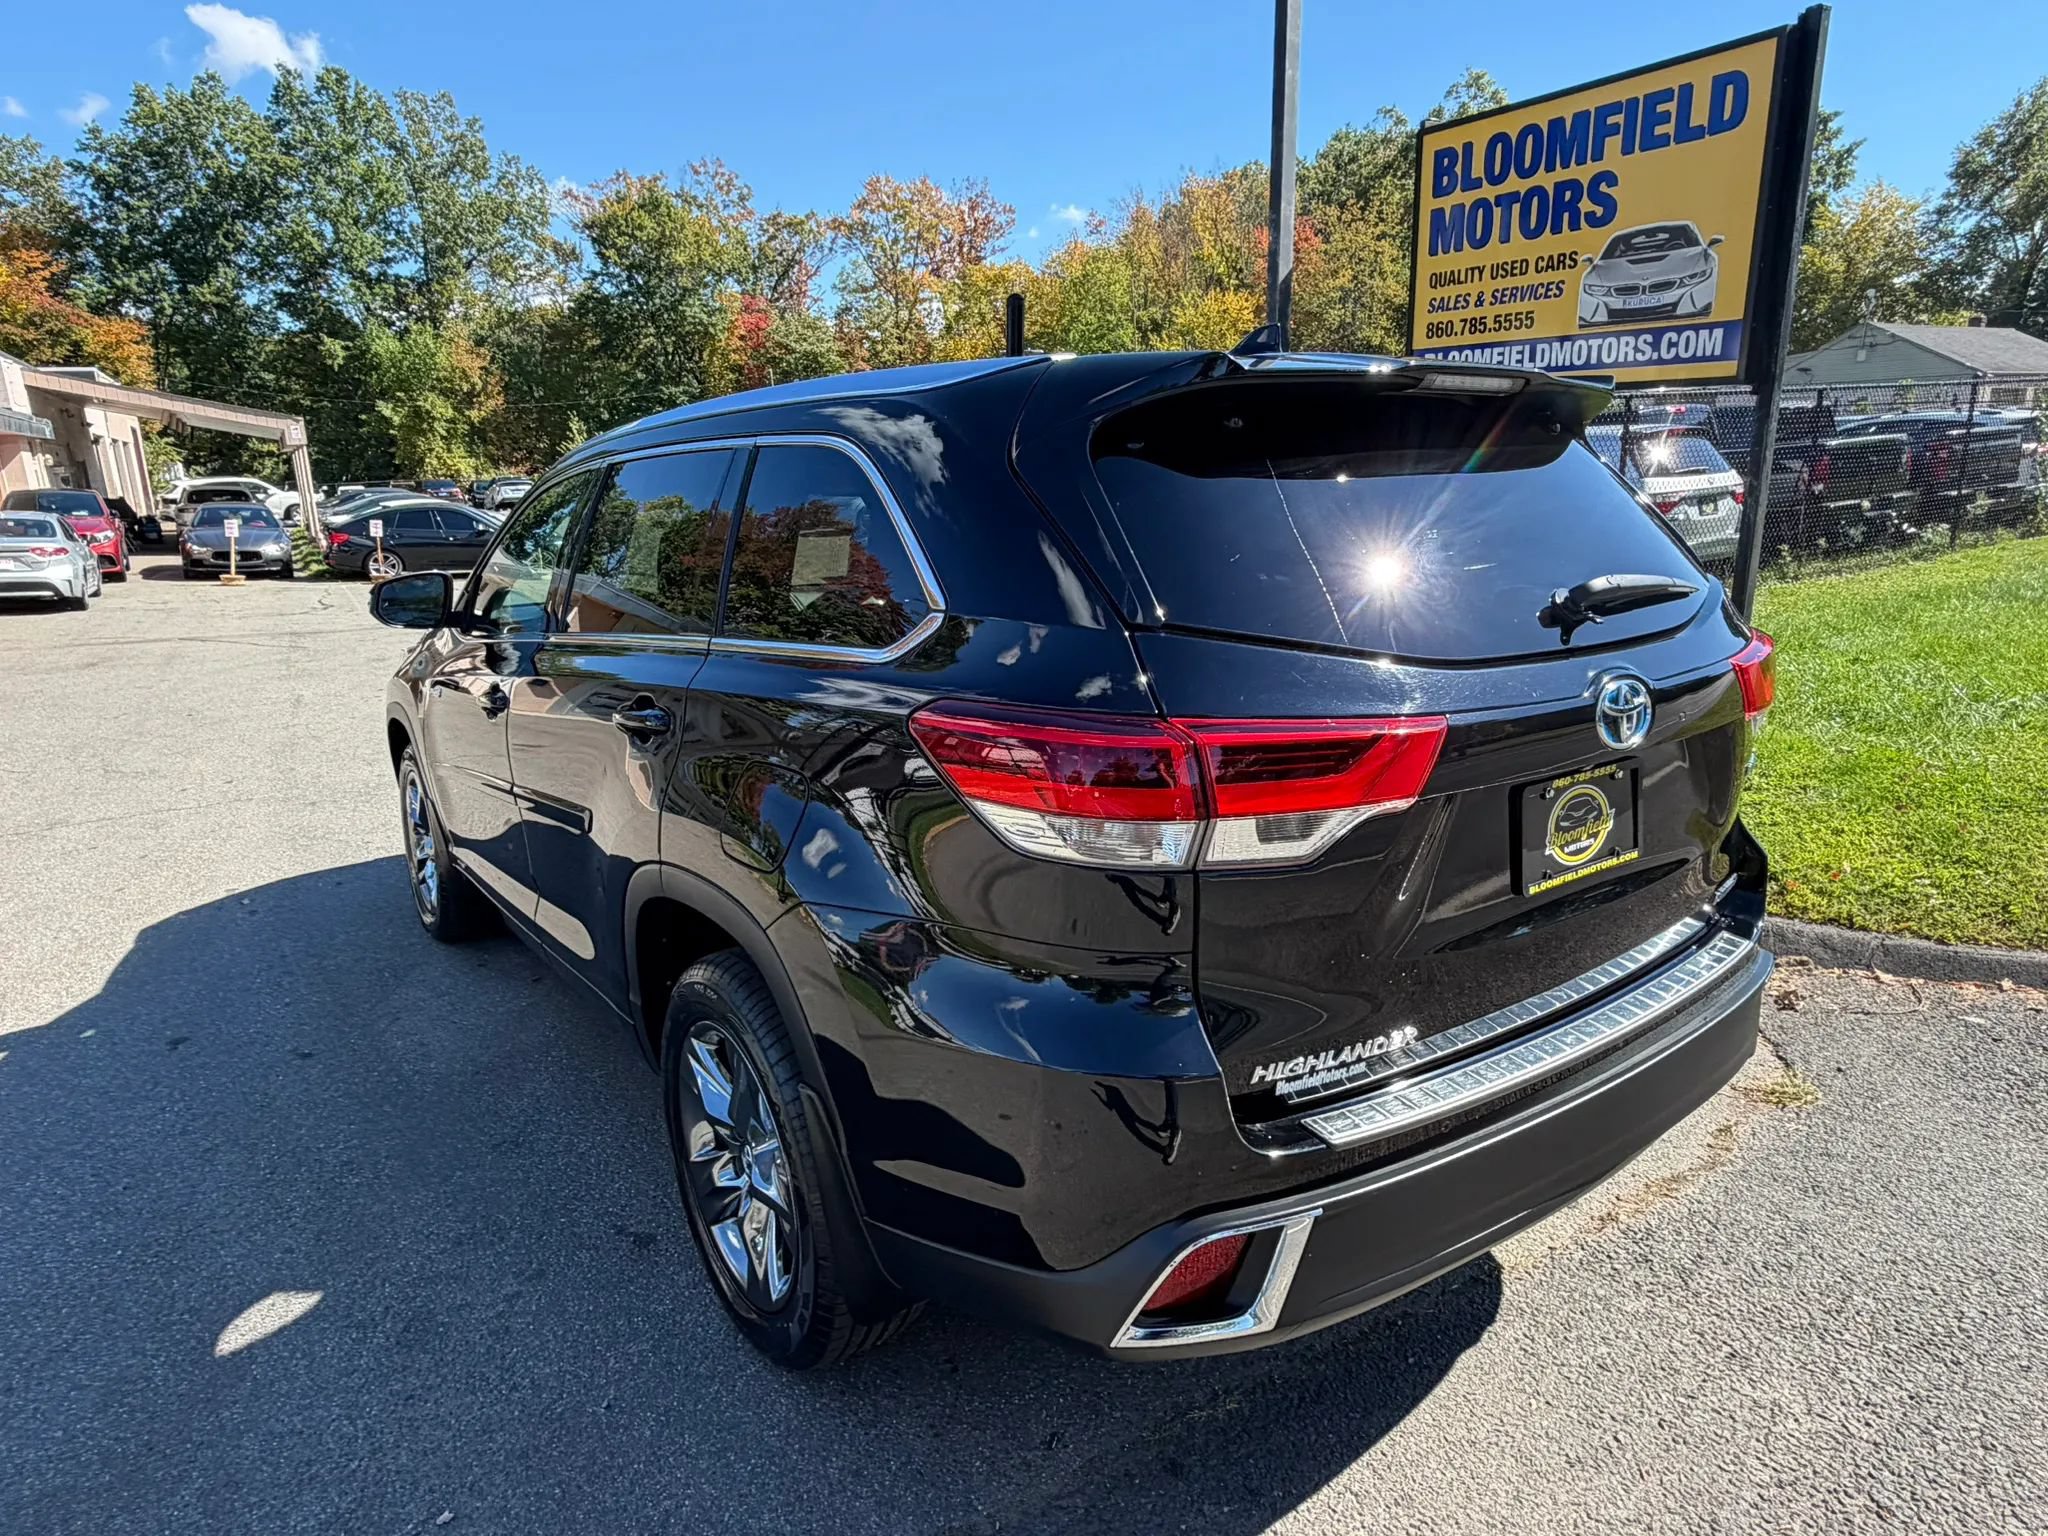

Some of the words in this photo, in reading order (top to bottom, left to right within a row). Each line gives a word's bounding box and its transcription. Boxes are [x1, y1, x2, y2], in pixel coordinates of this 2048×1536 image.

[1432, 70, 1749, 199] BLOOMFIELD
[1428, 170, 1619, 257] MOTORS
[1429, 265, 1487, 289] QUALITY
[1490, 257, 1529, 280] USED
[1534, 250, 1579, 274] CARS
[1427, 293, 1471, 314] SALES
[1474, 290, 1485, 308] &
[1489, 280, 1566, 306] SERVICES
[1426, 310, 1535, 340] 860.785.5555
[1552, 764, 1617, 789] 860-785-5555
[1550, 815, 1612, 848] Bloomfield
[1528, 850, 1639, 895] BLOOMFIELDMOTORS.COM
[1250, 1025, 1418, 1084] HIGHLANDER
[1275, 1062, 1367, 1096] BloomfieldMotors.com
